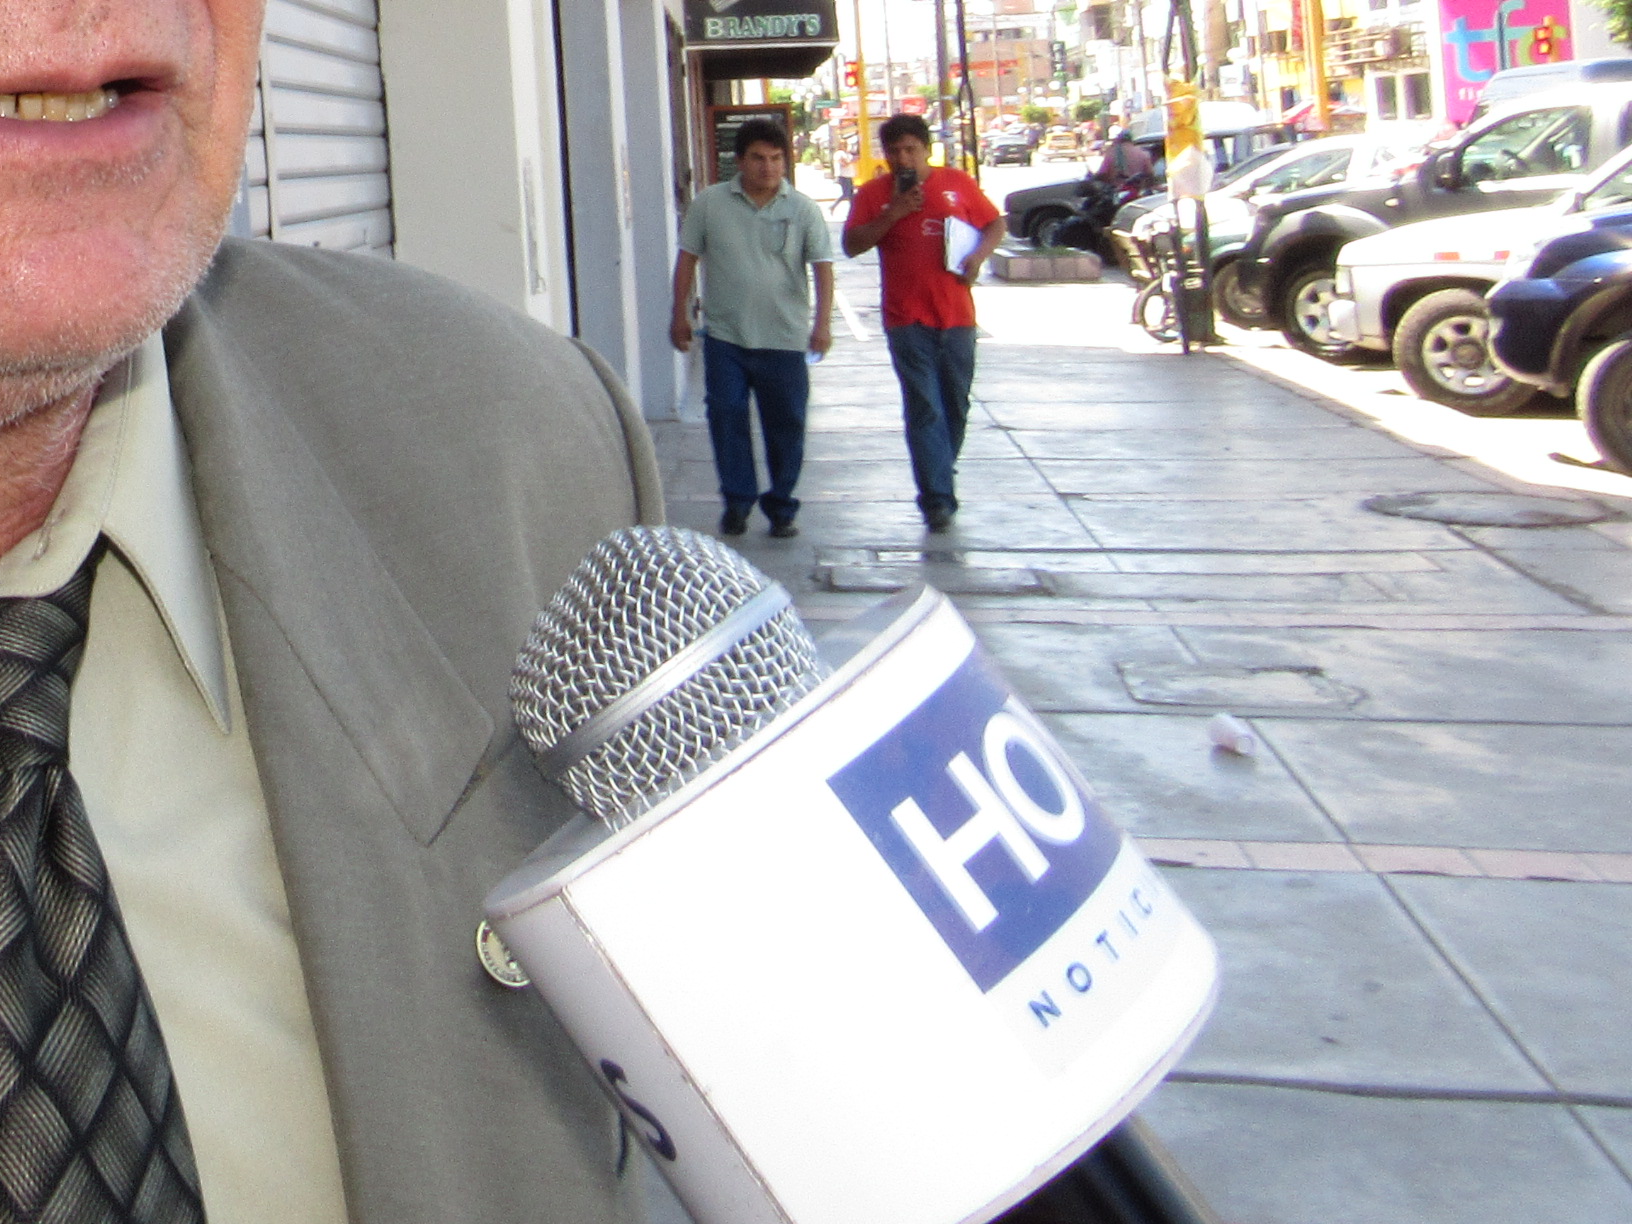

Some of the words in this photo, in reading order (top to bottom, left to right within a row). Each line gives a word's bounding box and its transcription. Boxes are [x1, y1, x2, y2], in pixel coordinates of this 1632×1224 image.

[703, 13, 821, 39] BRANDY'S
[888, 694, 1086, 935] HO
[1028, 886, 1154, 1029] NOTIC
